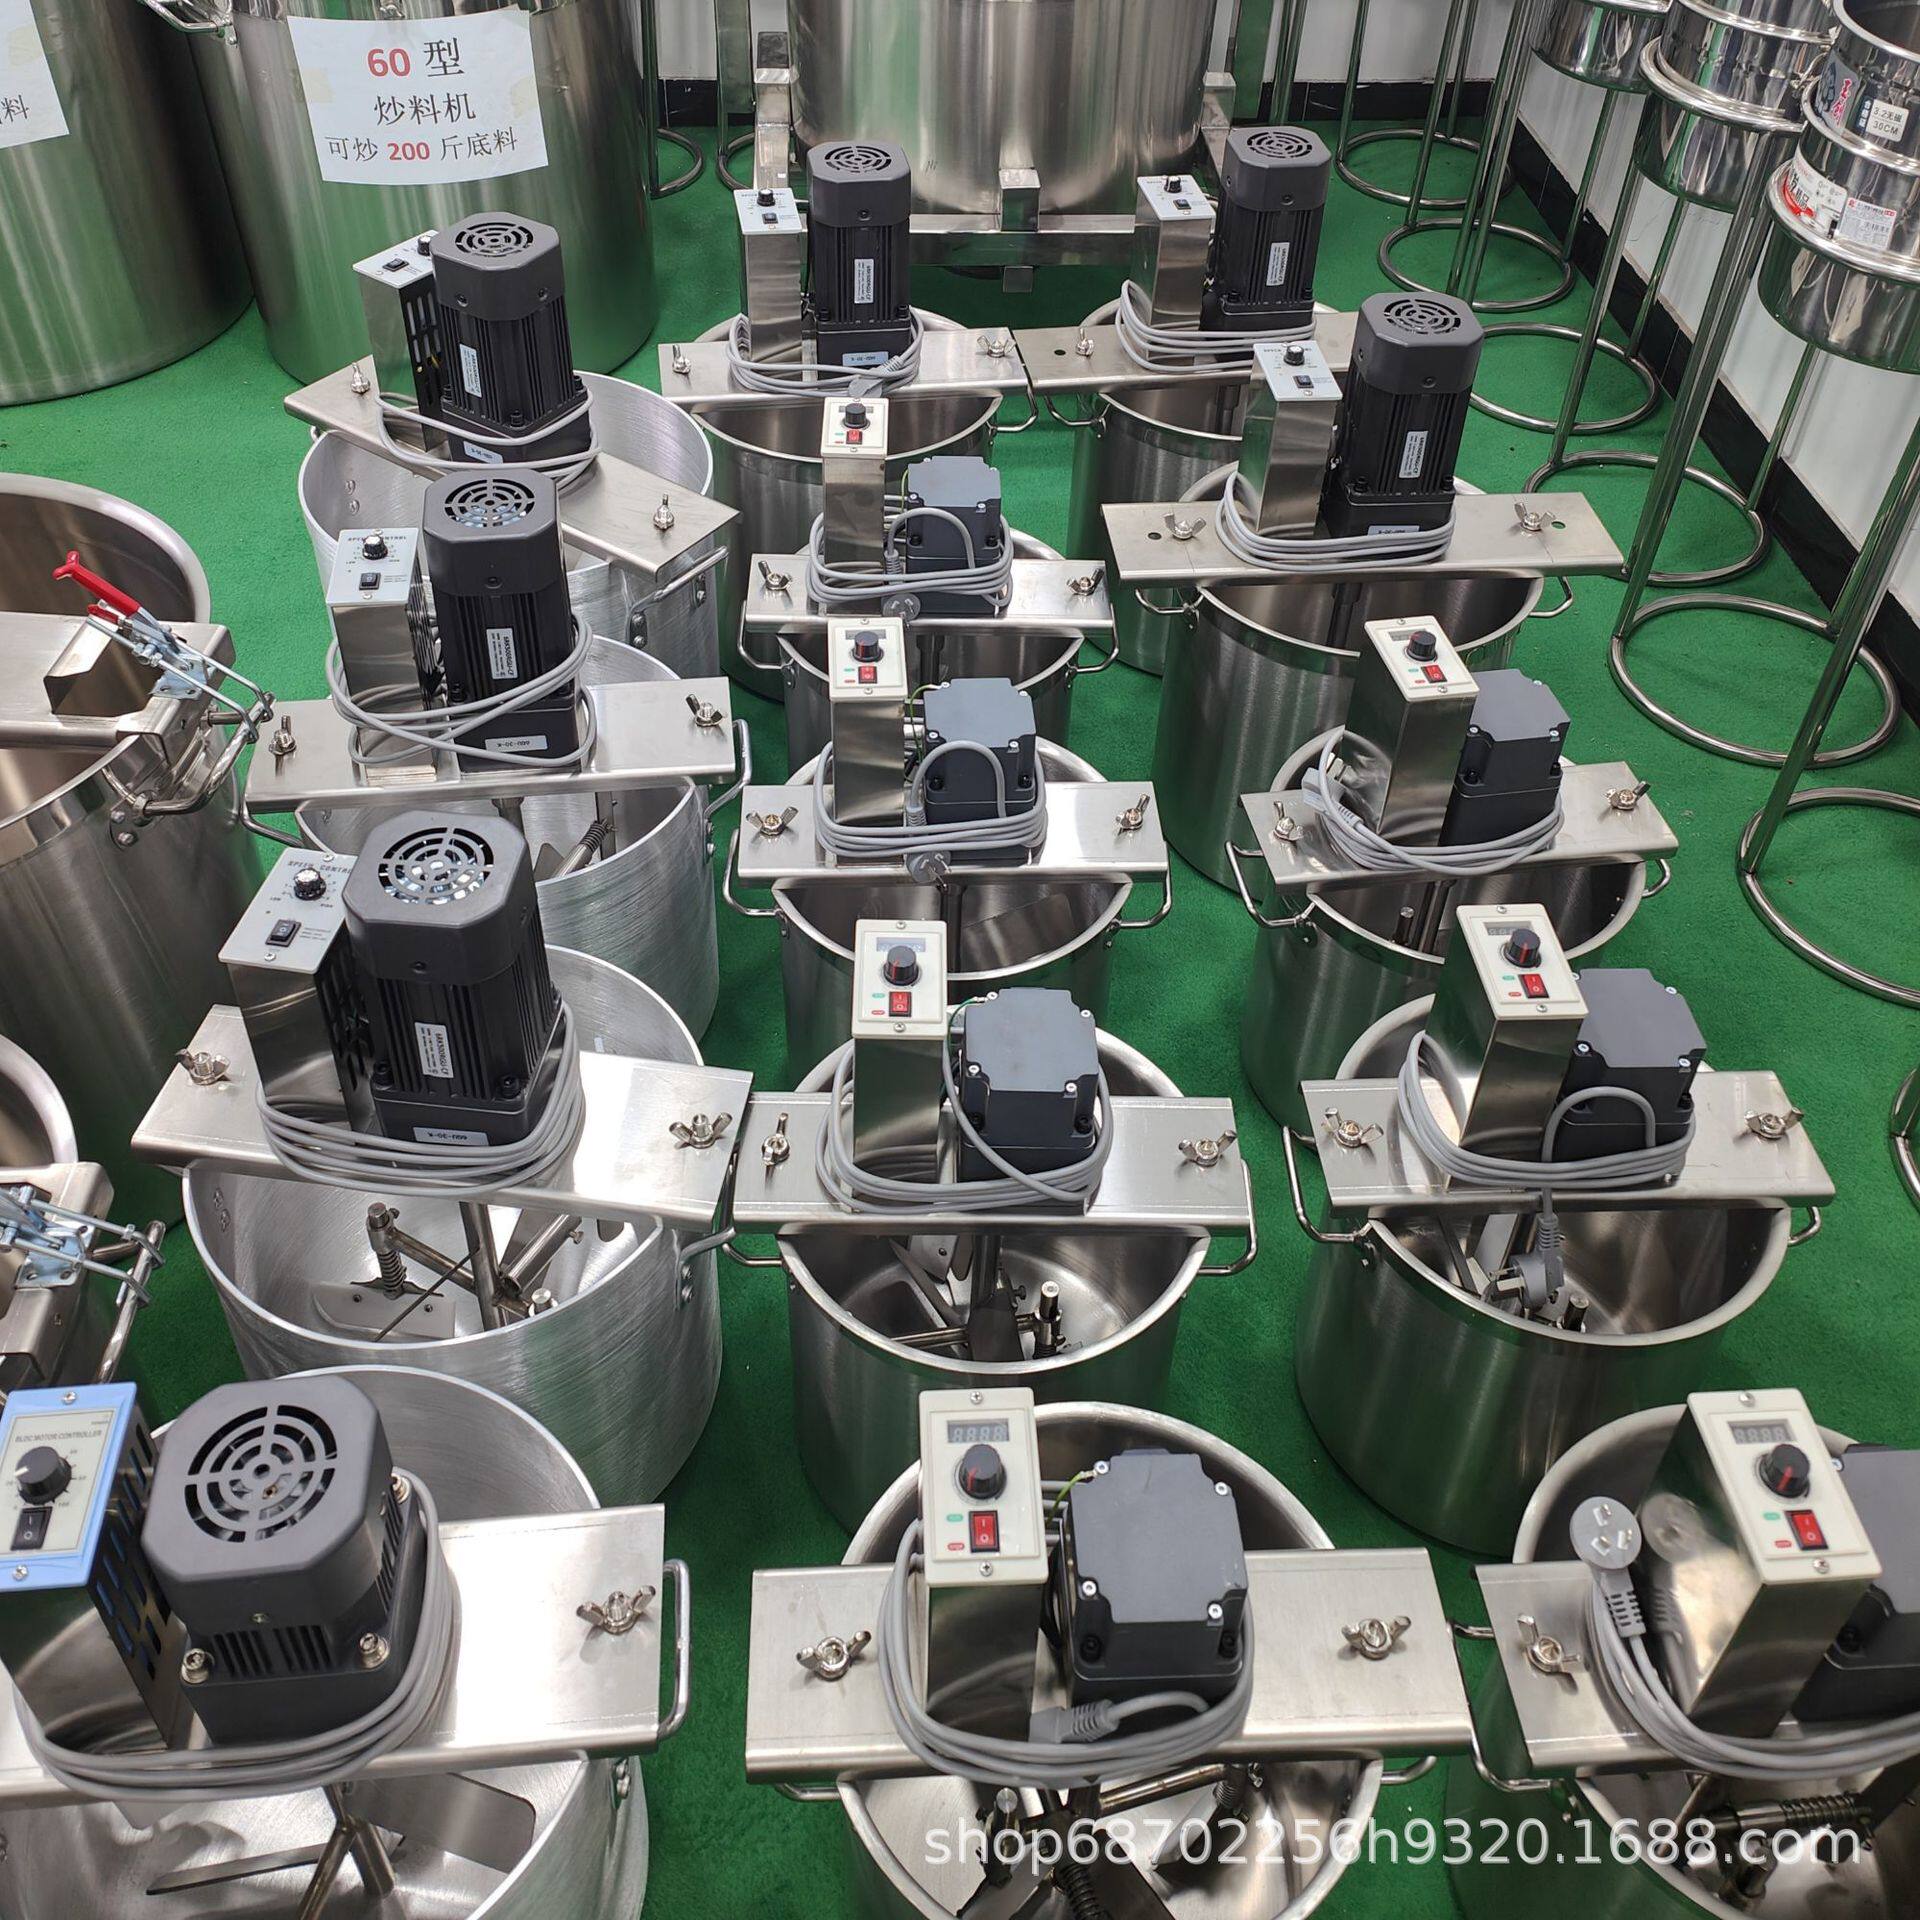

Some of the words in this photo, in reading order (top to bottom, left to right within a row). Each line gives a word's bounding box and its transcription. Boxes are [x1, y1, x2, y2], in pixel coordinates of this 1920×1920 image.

[367, 48, 411, 77] 60
[424, 37, 465, 77] 型
[0, 94, 29, 124] 料
[373, 92, 476, 126] 炒料机
[325, 136, 378, 162] 可炒
[387, 142, 430, 161] 200
[441, 126, 517, 161] 斤底料
[1872, 120, 1899, 135] 30CM
